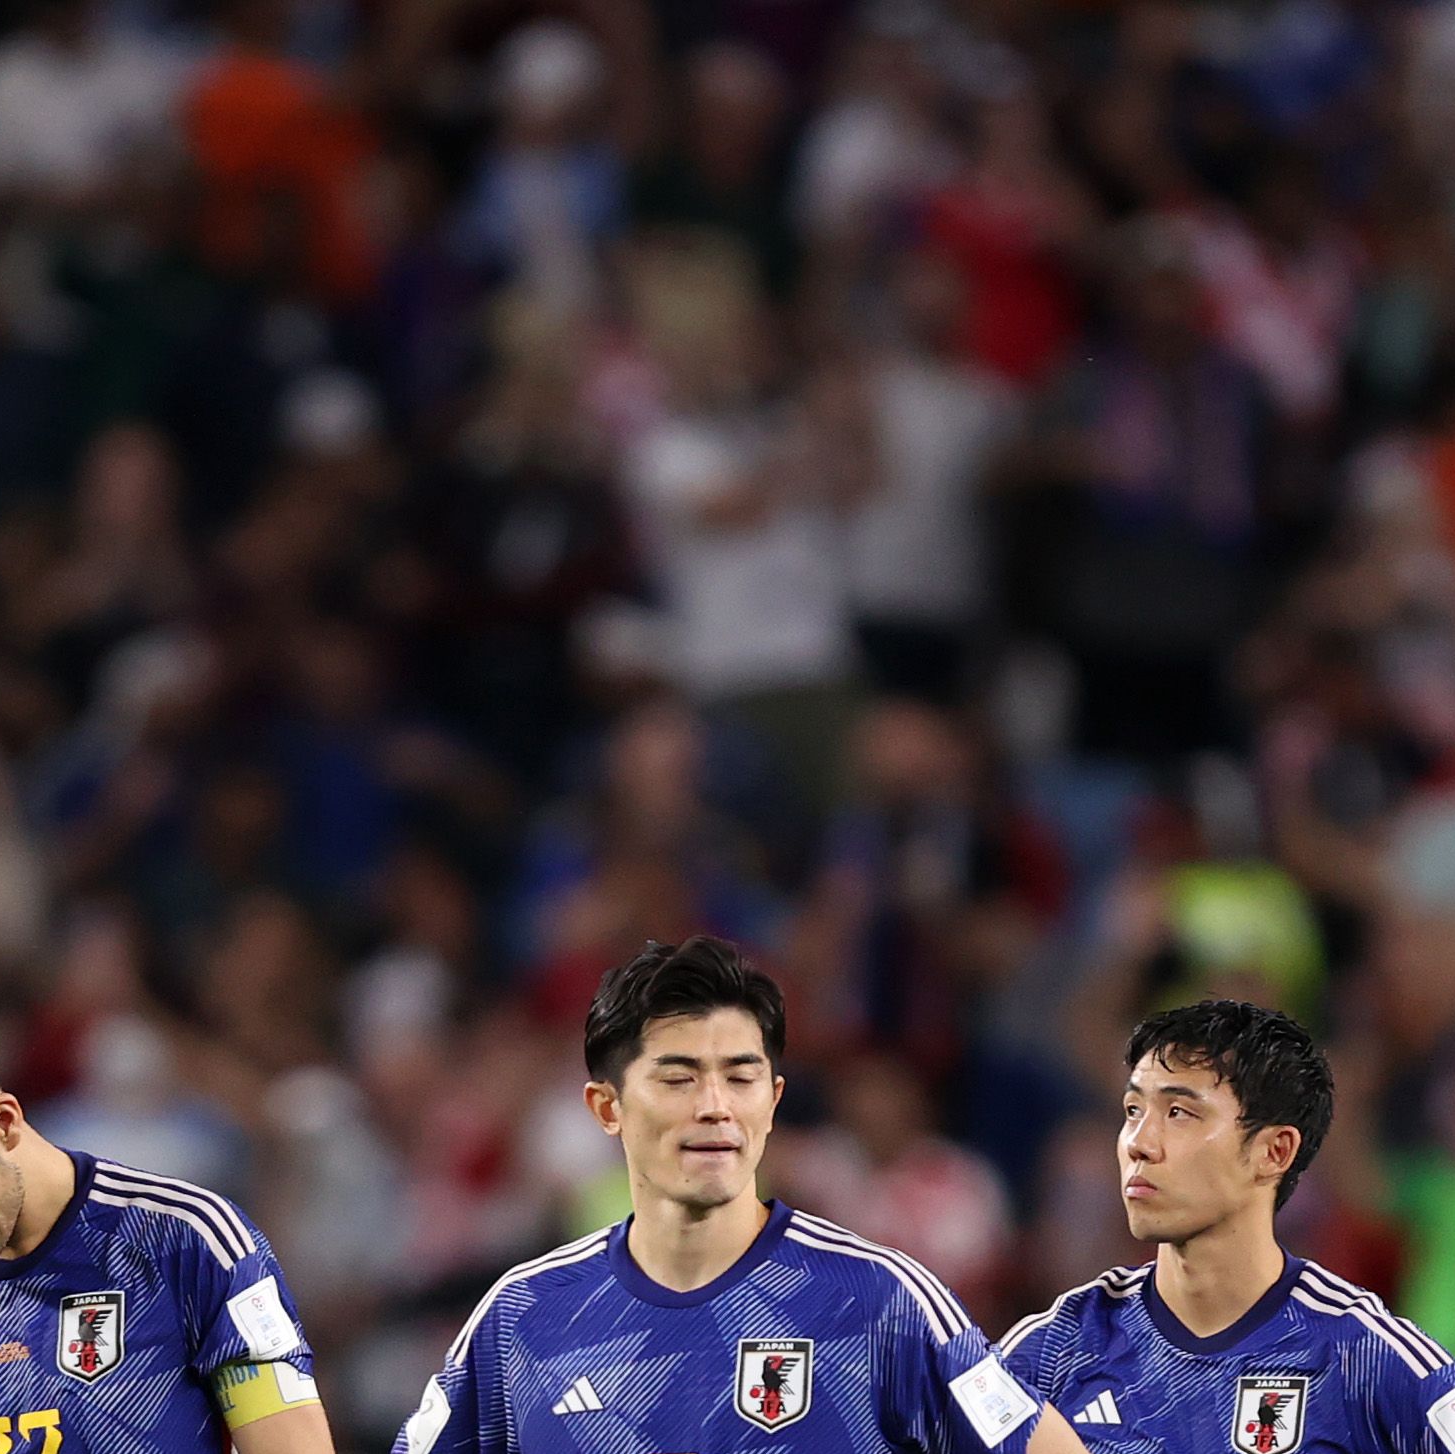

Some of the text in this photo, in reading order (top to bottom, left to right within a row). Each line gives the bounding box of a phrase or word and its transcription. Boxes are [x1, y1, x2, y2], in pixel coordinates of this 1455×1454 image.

[72, 1295, 106, 1306] JAPAN
[756, 1342, 795, 1351] JAPAN
[1254, 1380, 1291, 1388] JAPAN
[755, 1400, 787, 1414] JFA
[1249, 1434, 1280, 1448] JFA
